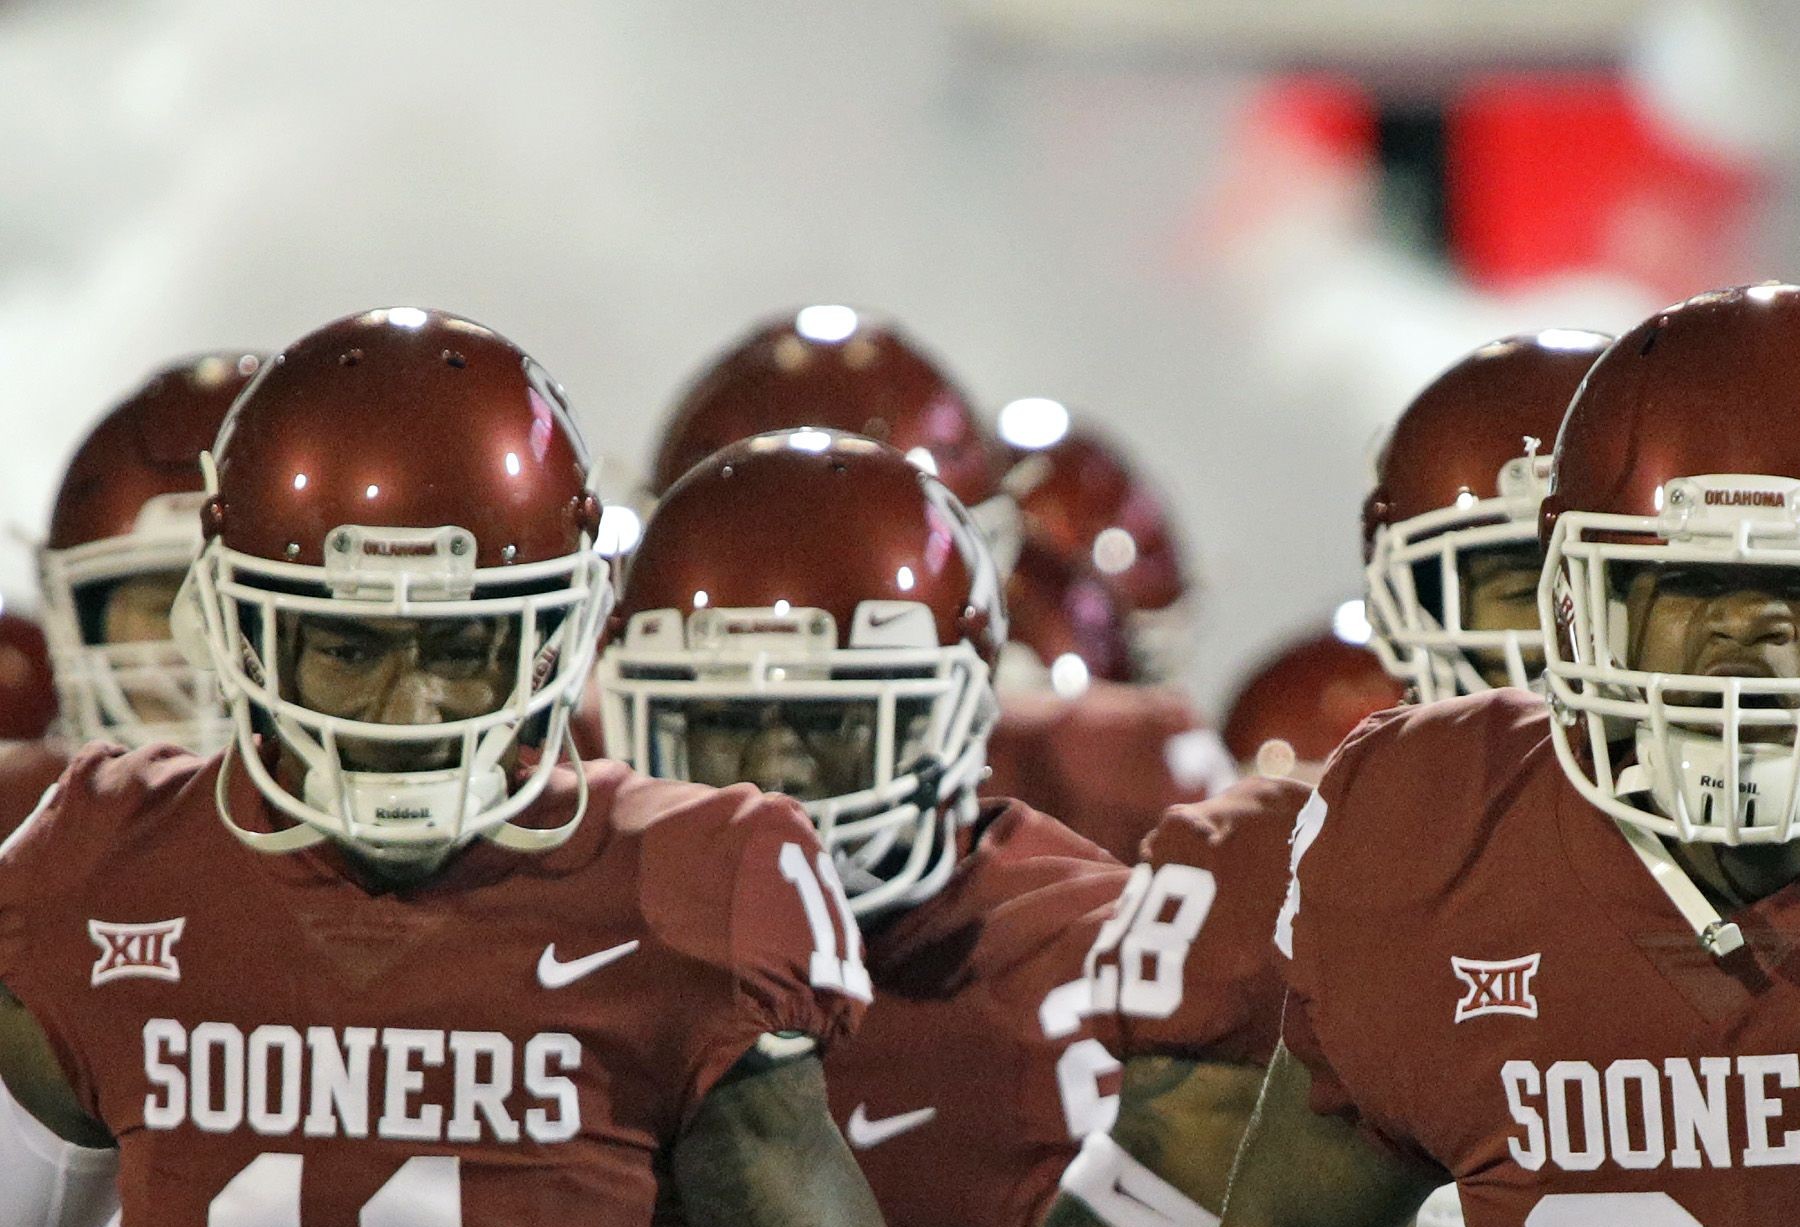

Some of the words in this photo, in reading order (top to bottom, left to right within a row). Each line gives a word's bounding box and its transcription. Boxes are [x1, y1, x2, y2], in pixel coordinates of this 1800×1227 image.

[1704, 489, 1785, 508] OKLAHOMA
[1455, 957, 1537, 1018] XII
[143, 1018, 582, 1144] SOONERS
